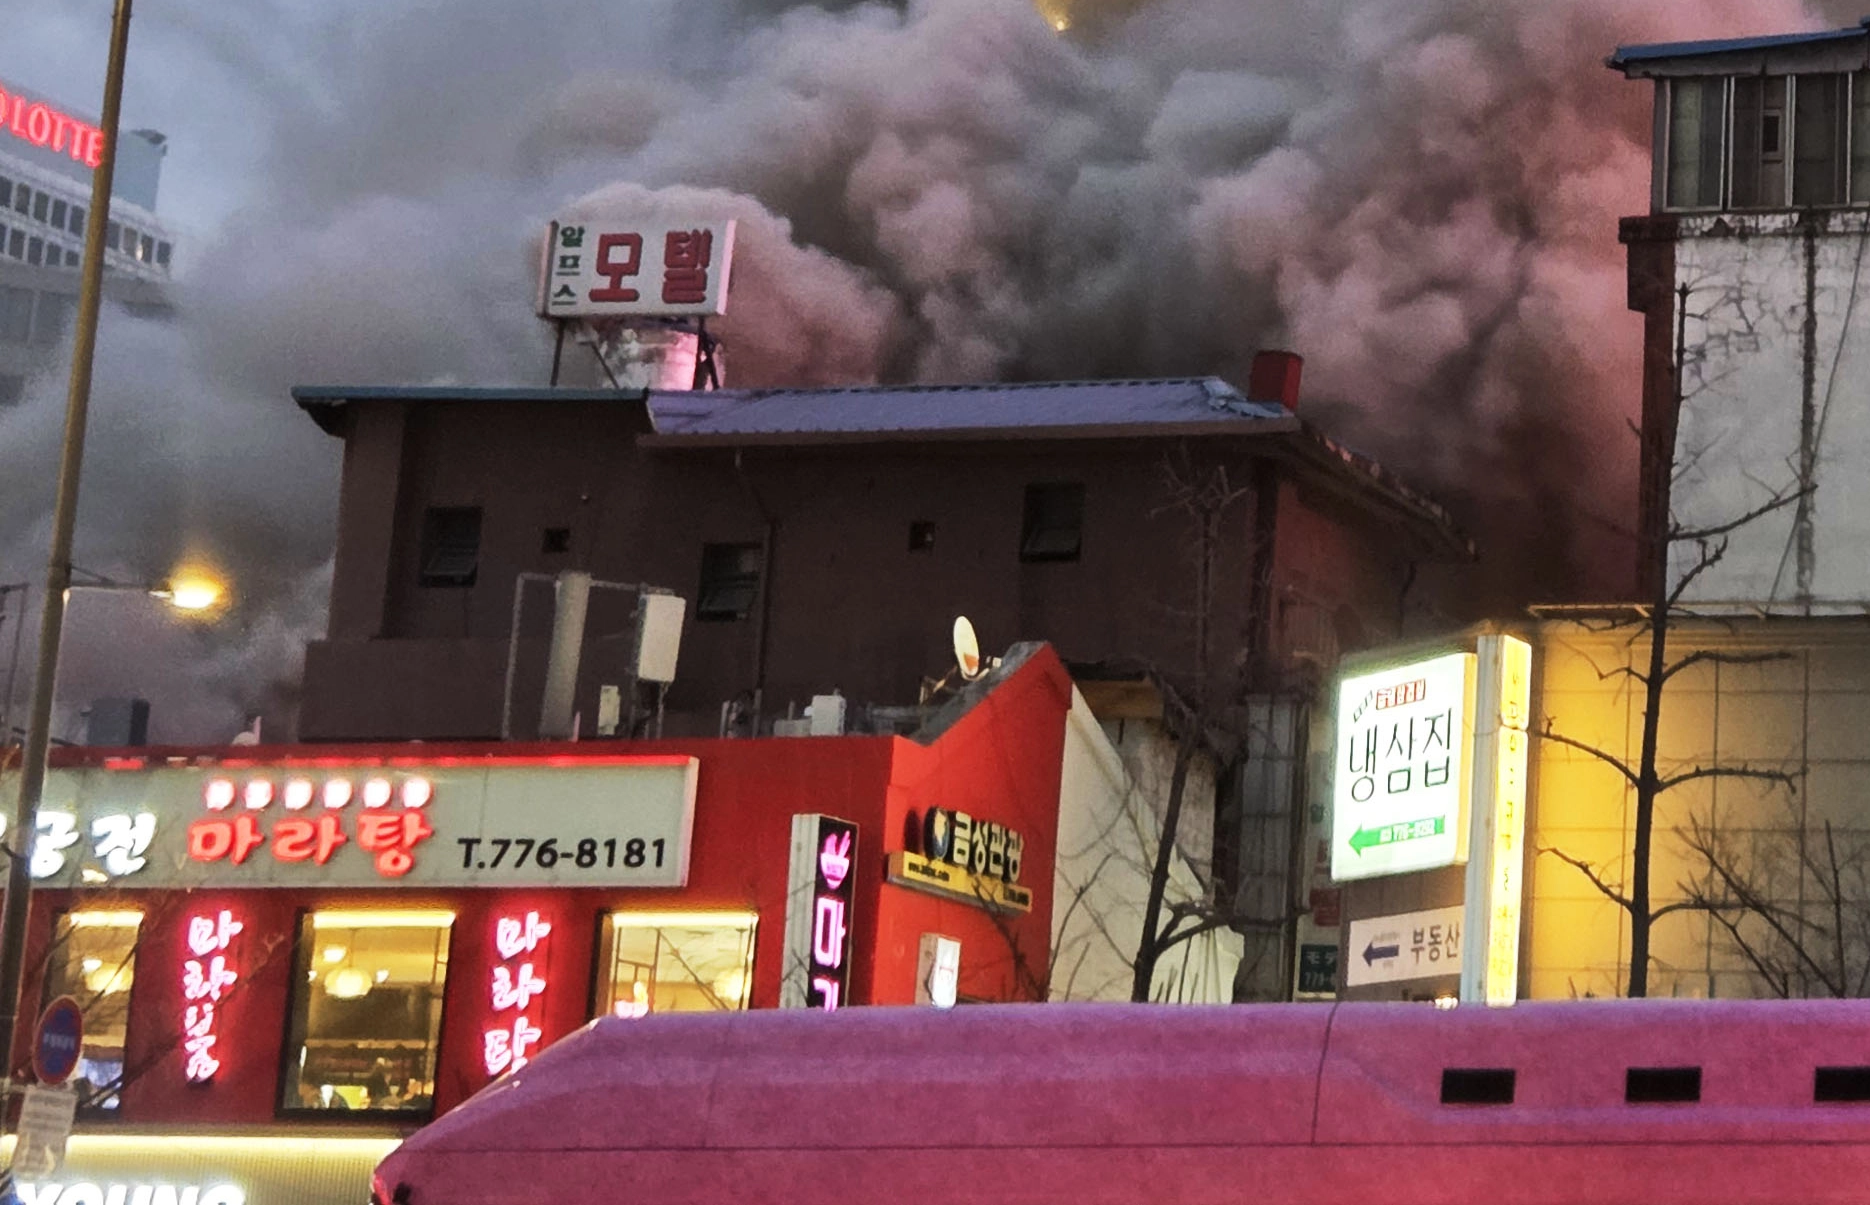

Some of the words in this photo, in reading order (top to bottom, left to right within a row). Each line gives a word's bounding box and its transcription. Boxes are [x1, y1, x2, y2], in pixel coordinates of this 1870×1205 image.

[9, 95, 104, 168] LOTTE
[551, 226, 585, 306] 알프스
[588, 228, 713, 304] 모텔
[1350, 707, 1452, 802] 냉삼집
[188, 806, 435, 877] 마라탕
[457, 837, 666, 869] T.776-8181
[1411, 922, 1460, 965] 부동산
